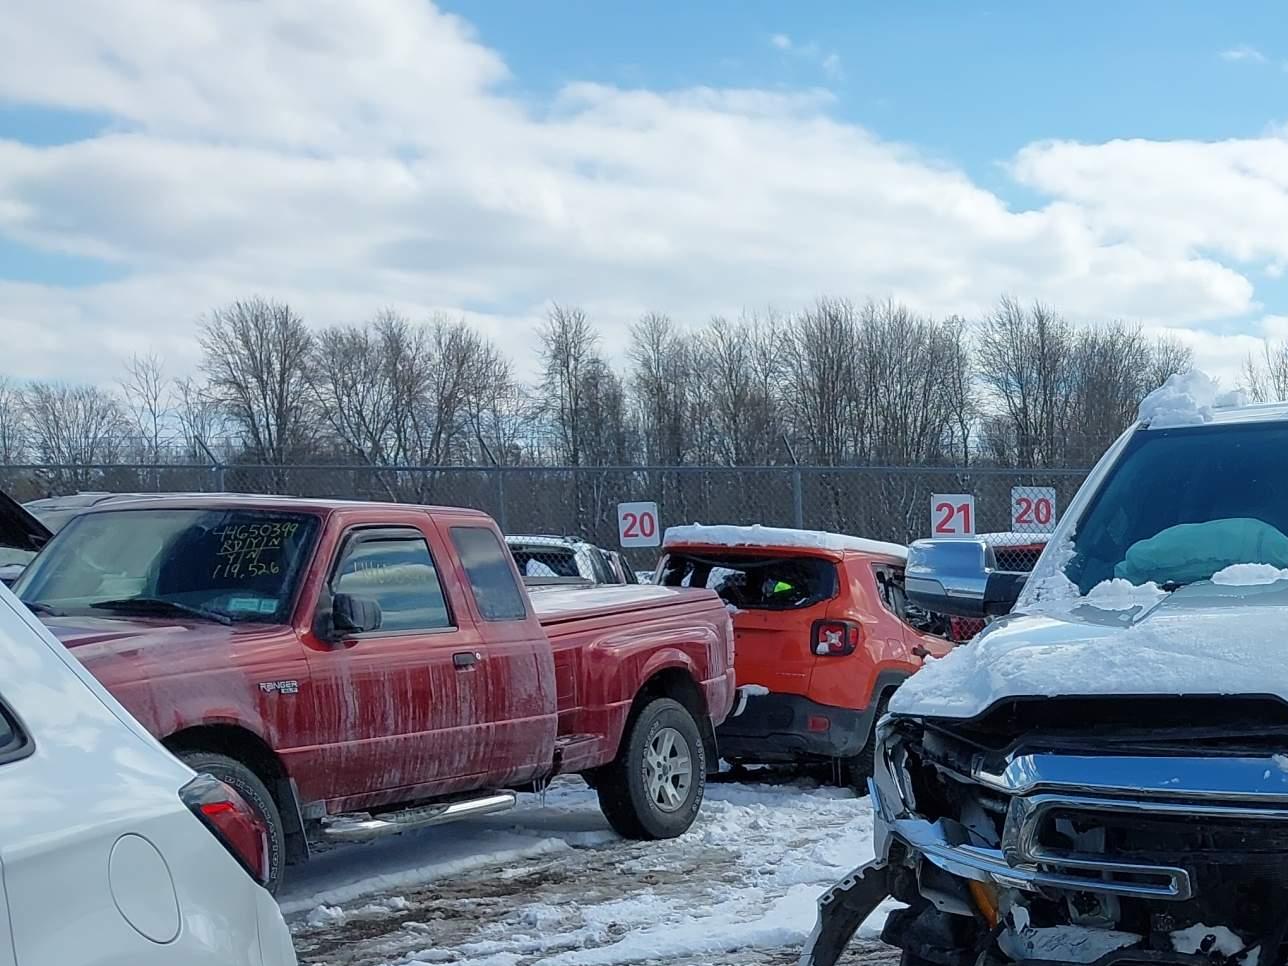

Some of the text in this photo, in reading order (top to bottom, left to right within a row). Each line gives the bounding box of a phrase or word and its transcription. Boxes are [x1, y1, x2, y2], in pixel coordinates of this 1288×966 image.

[935, 502, 971, 534] 21
[1015, 498, 1052, 525] 20
[212, 521, 299, 542] 44650399
[623, 512, 655, 538] 20
